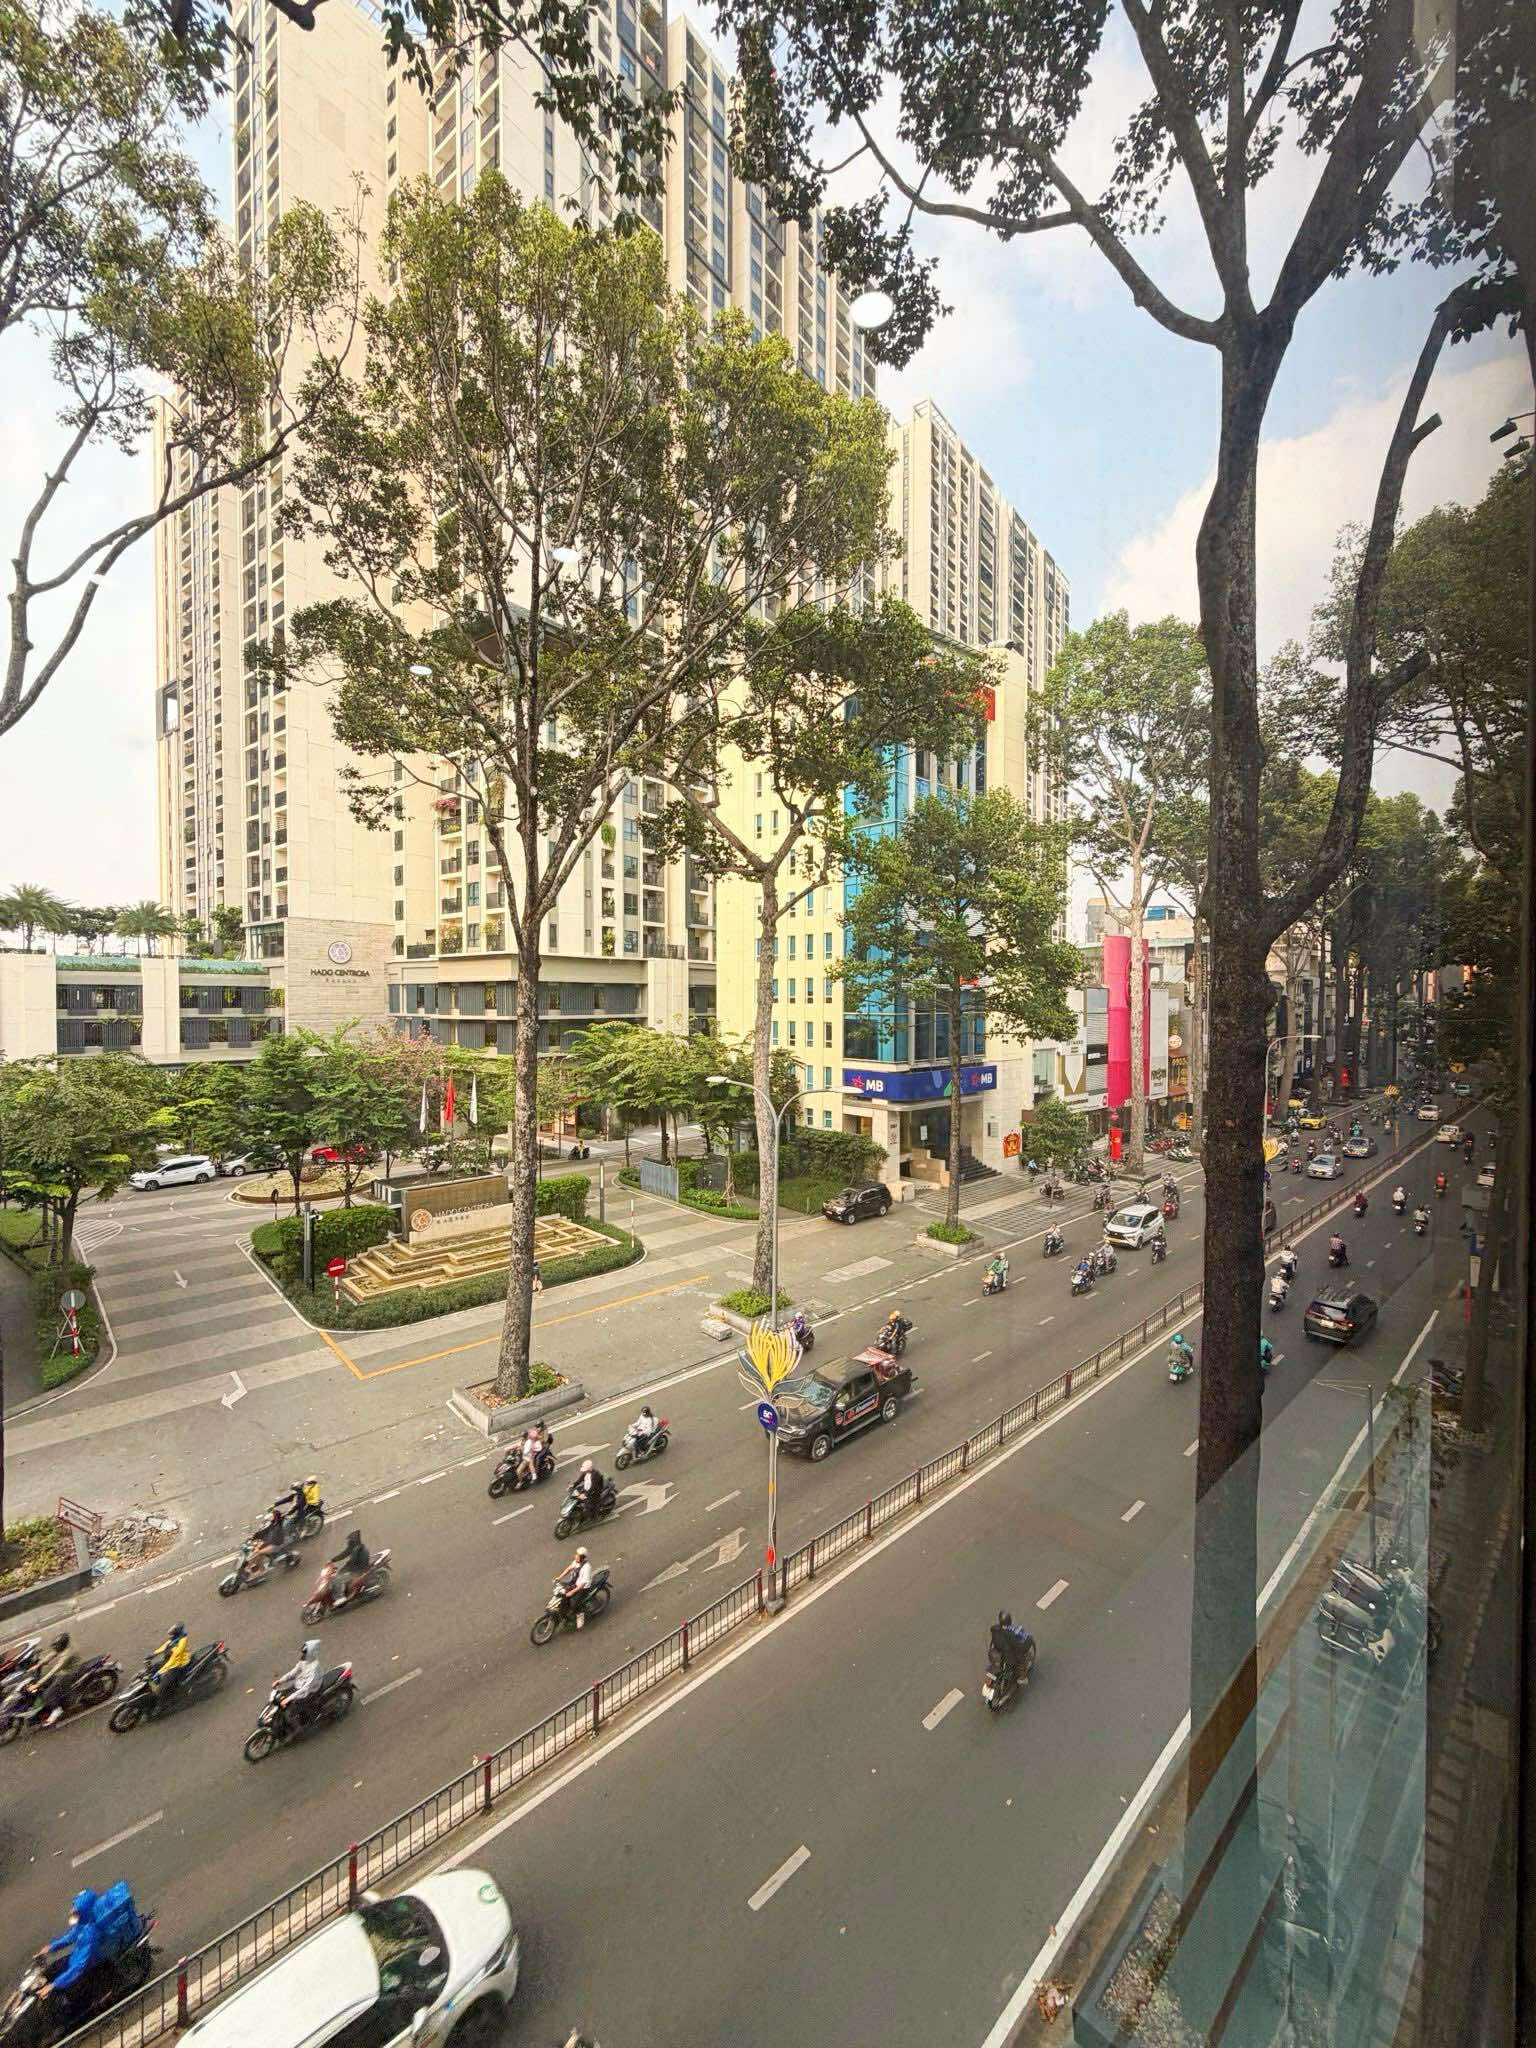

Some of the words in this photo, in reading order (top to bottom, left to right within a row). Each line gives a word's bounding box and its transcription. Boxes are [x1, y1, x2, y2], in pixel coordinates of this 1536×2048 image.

[310, 969, 333, 977] HADO
[335, 969, 370, 977] CENTROSA
[981, 1072, 993, 1084] MB
[866, 1079, 884, 1092] MB
